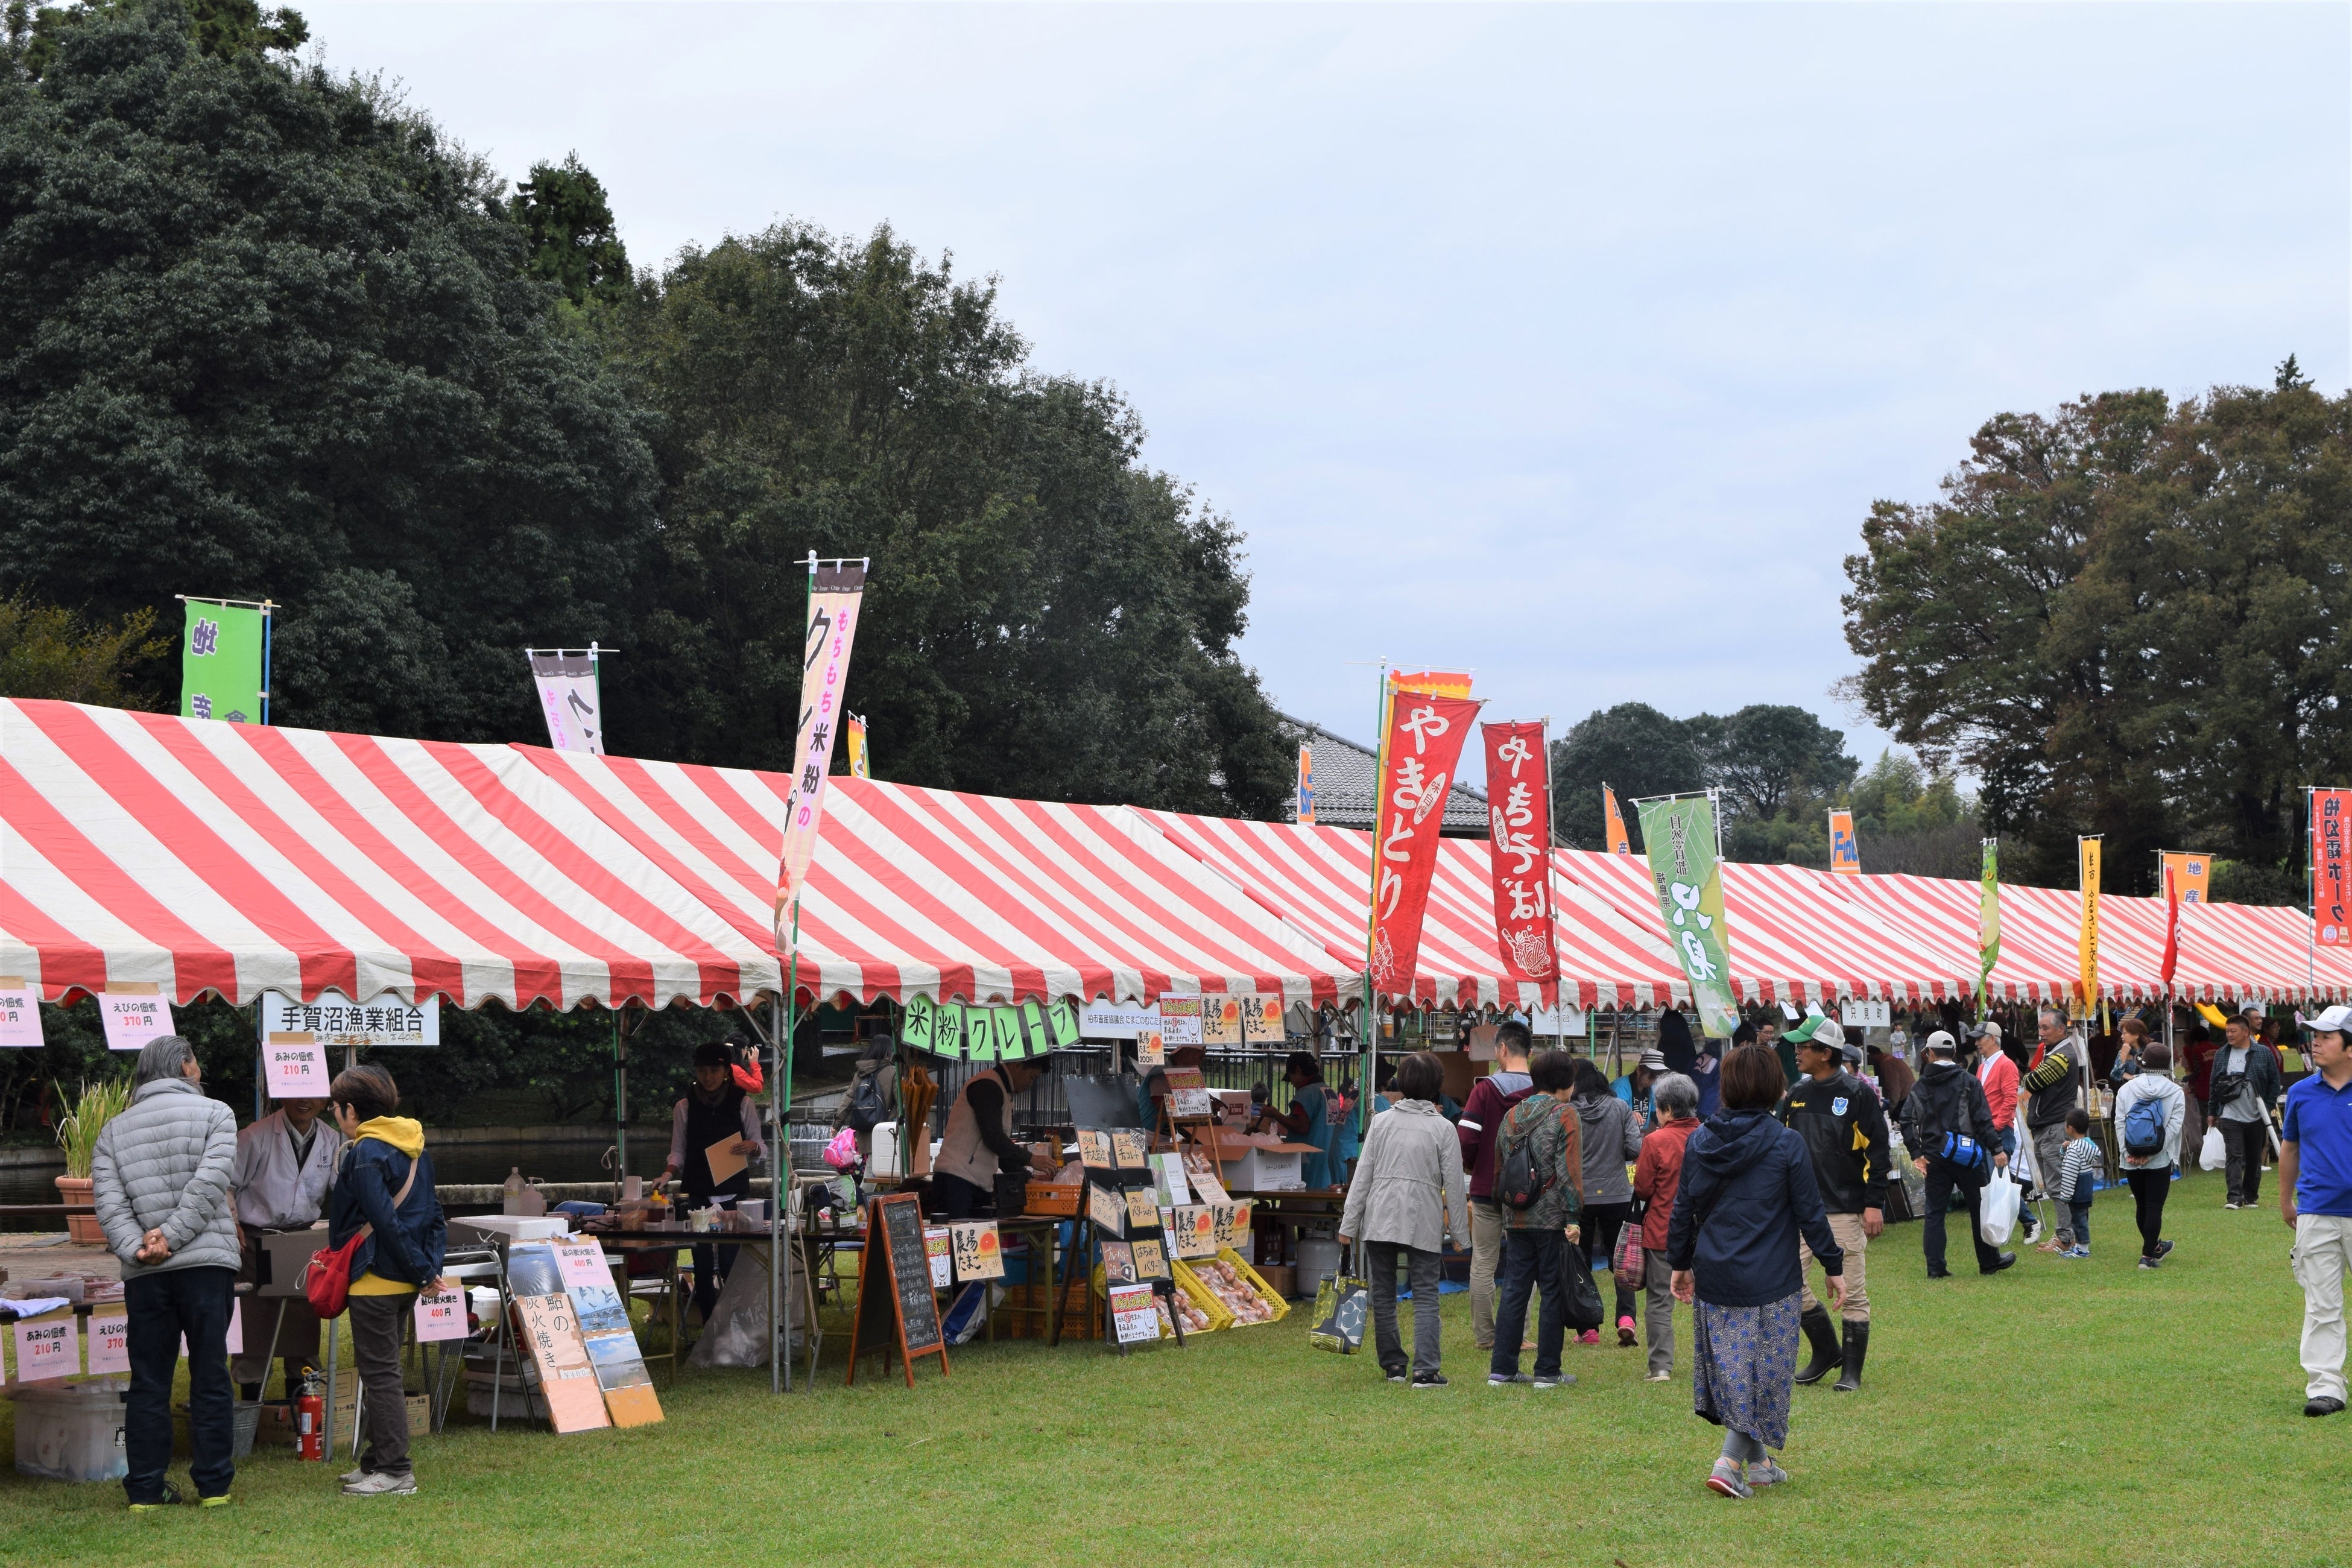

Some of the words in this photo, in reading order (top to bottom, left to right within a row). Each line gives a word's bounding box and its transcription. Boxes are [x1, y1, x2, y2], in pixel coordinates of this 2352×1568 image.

[797, 610, 849, 827] もちもち米粉の
[1416, 781, 1441, 818] 味自慢
[1379, 705, 1449, 920] やきとり
[2184, 862, 2202, 902] 地産
[113, 1002, 158, 1013] えびの佃煮
[1203, 997, 1222, 1020] 農場
[1243, 996, 1263, 1019] 農場
[1851, 1007, 1882, 1020] 只見町
[124, 1016, 153, 1026] 370円
[281, 1005, 424, 1032] 手賀沼漁業組合
[1087, 1014, 1125, 1025] 柏市畜産協議会
[1204, 1020, 1224, 1035] たまご
[1246, 1019, 1266, 1034] たまご
[1138, 1032, 1150, 1045] 農場
[275, 1052, 315, 1061] あみの佃煮
[1139, 1045, 1151, 1054] たまご
[283, 1064, 309, 1075] 210円
[1177, 1210, 1196, 1233] 農場
[1215, 1206, 1234, 1229] 農場
[954, 1228, 978, 1256] 農場
[1178, 1233, 1197, 1249] たまご
[1214, 1227, 1234, 1244] たまご
[561, 1248, 596, 1257] 鮎の炭火焼き
[1136, 1245, 1159, 1259] はちみつ
[958, 1254, 981, 1271] たまご
[421, 1295, 458, 1306] 鮎の炭火焼き
[431, 1307, 451, 1318] 400円
[26, 1326, 67, 1342] あみの佃煮
[34, 1342, 60, 1356] 210円
[107, 1337, 128, 1350] 370
